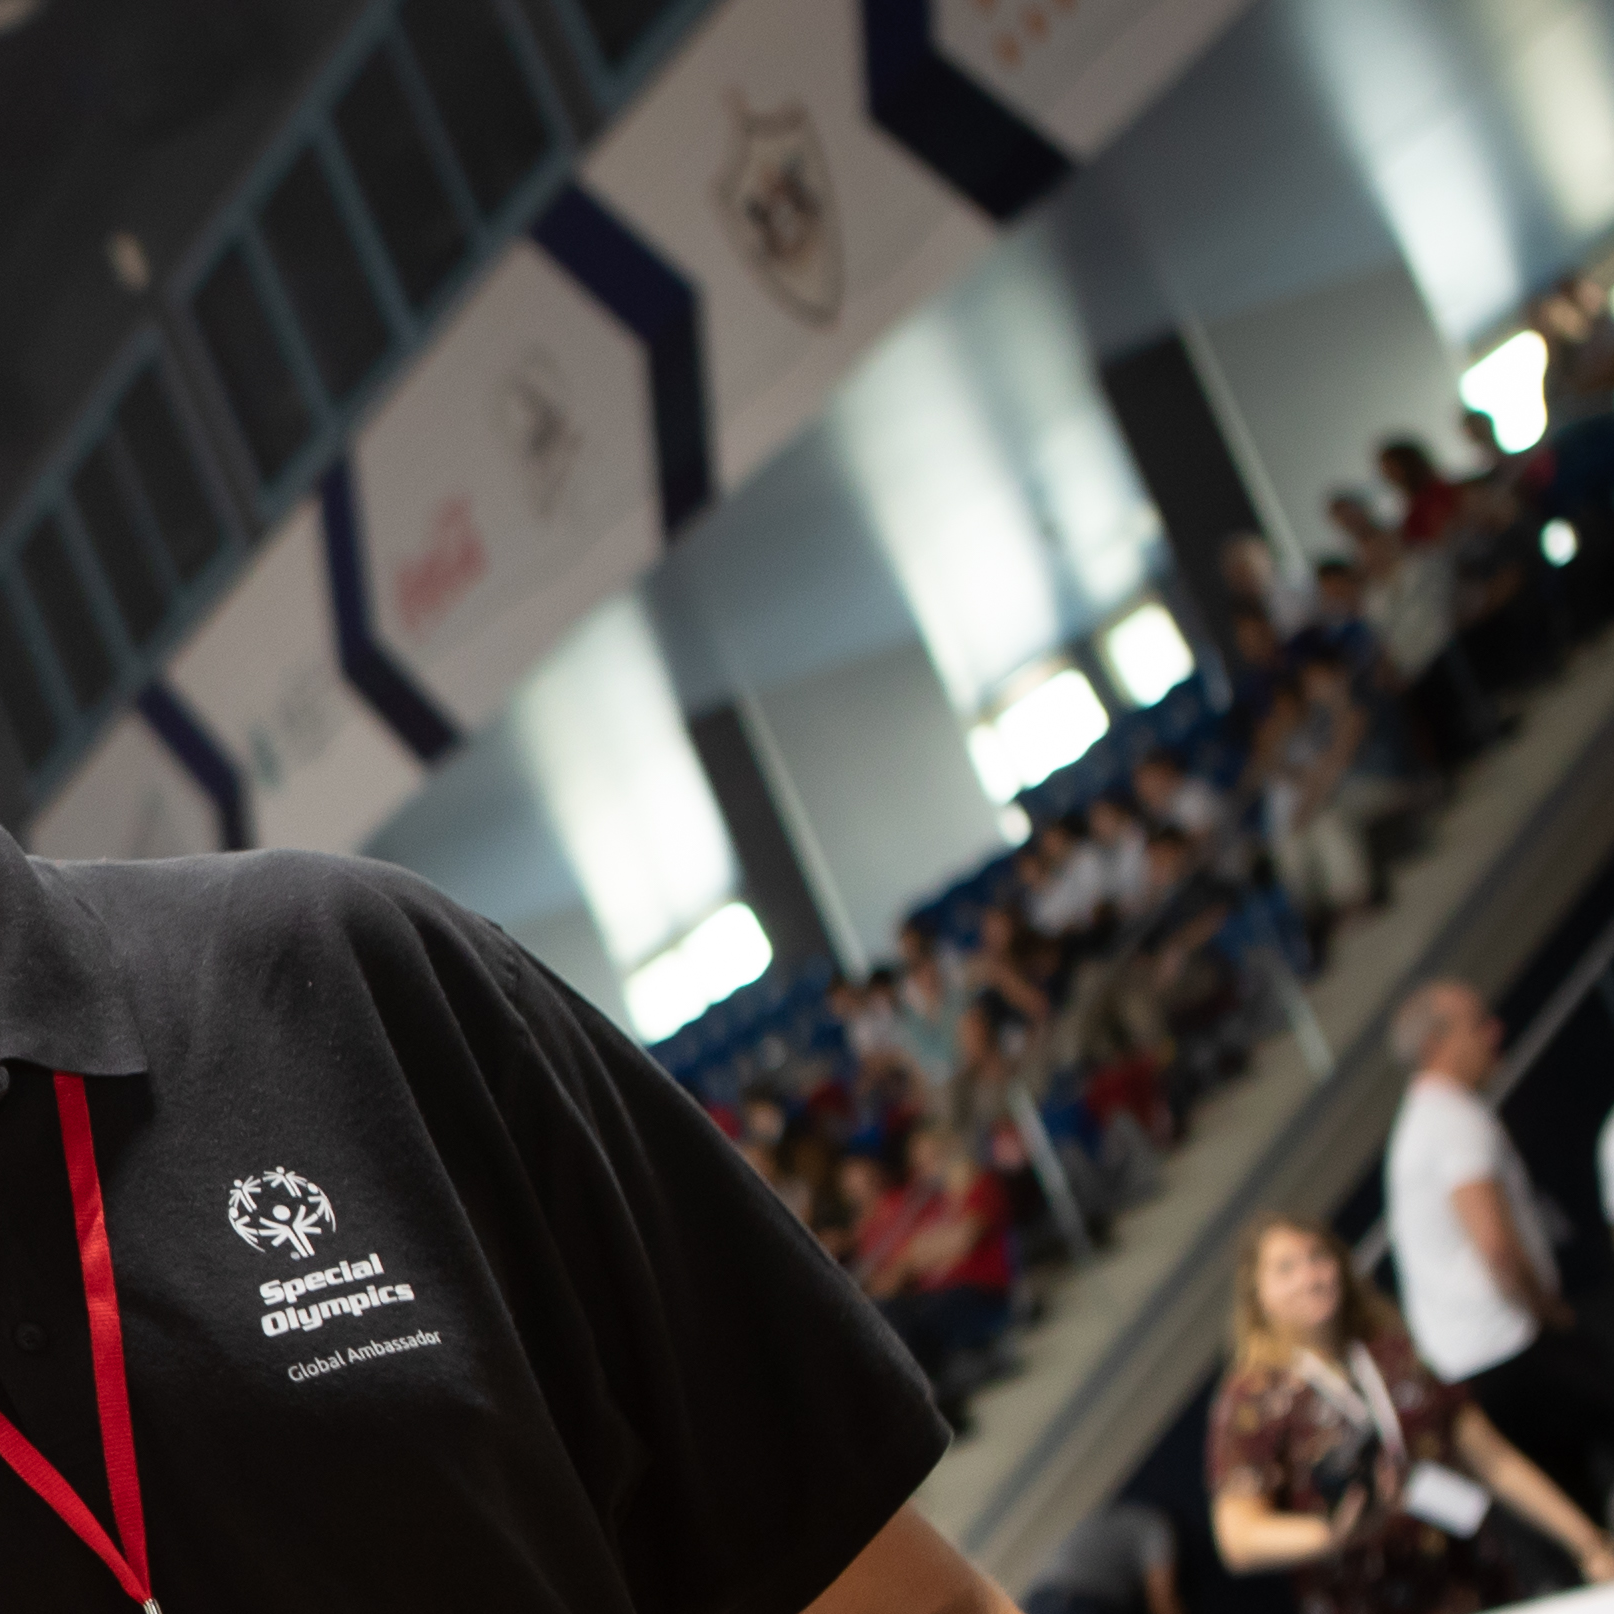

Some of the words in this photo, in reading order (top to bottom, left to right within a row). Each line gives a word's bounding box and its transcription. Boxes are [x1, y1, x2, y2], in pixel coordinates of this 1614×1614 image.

[259, 1252, 385, 1306] Special
[260, 1283, 415, 1337] Olympics
[287, 1350, 346, 1383] Global
[347, 1329, 443, 1364] Ambassador
